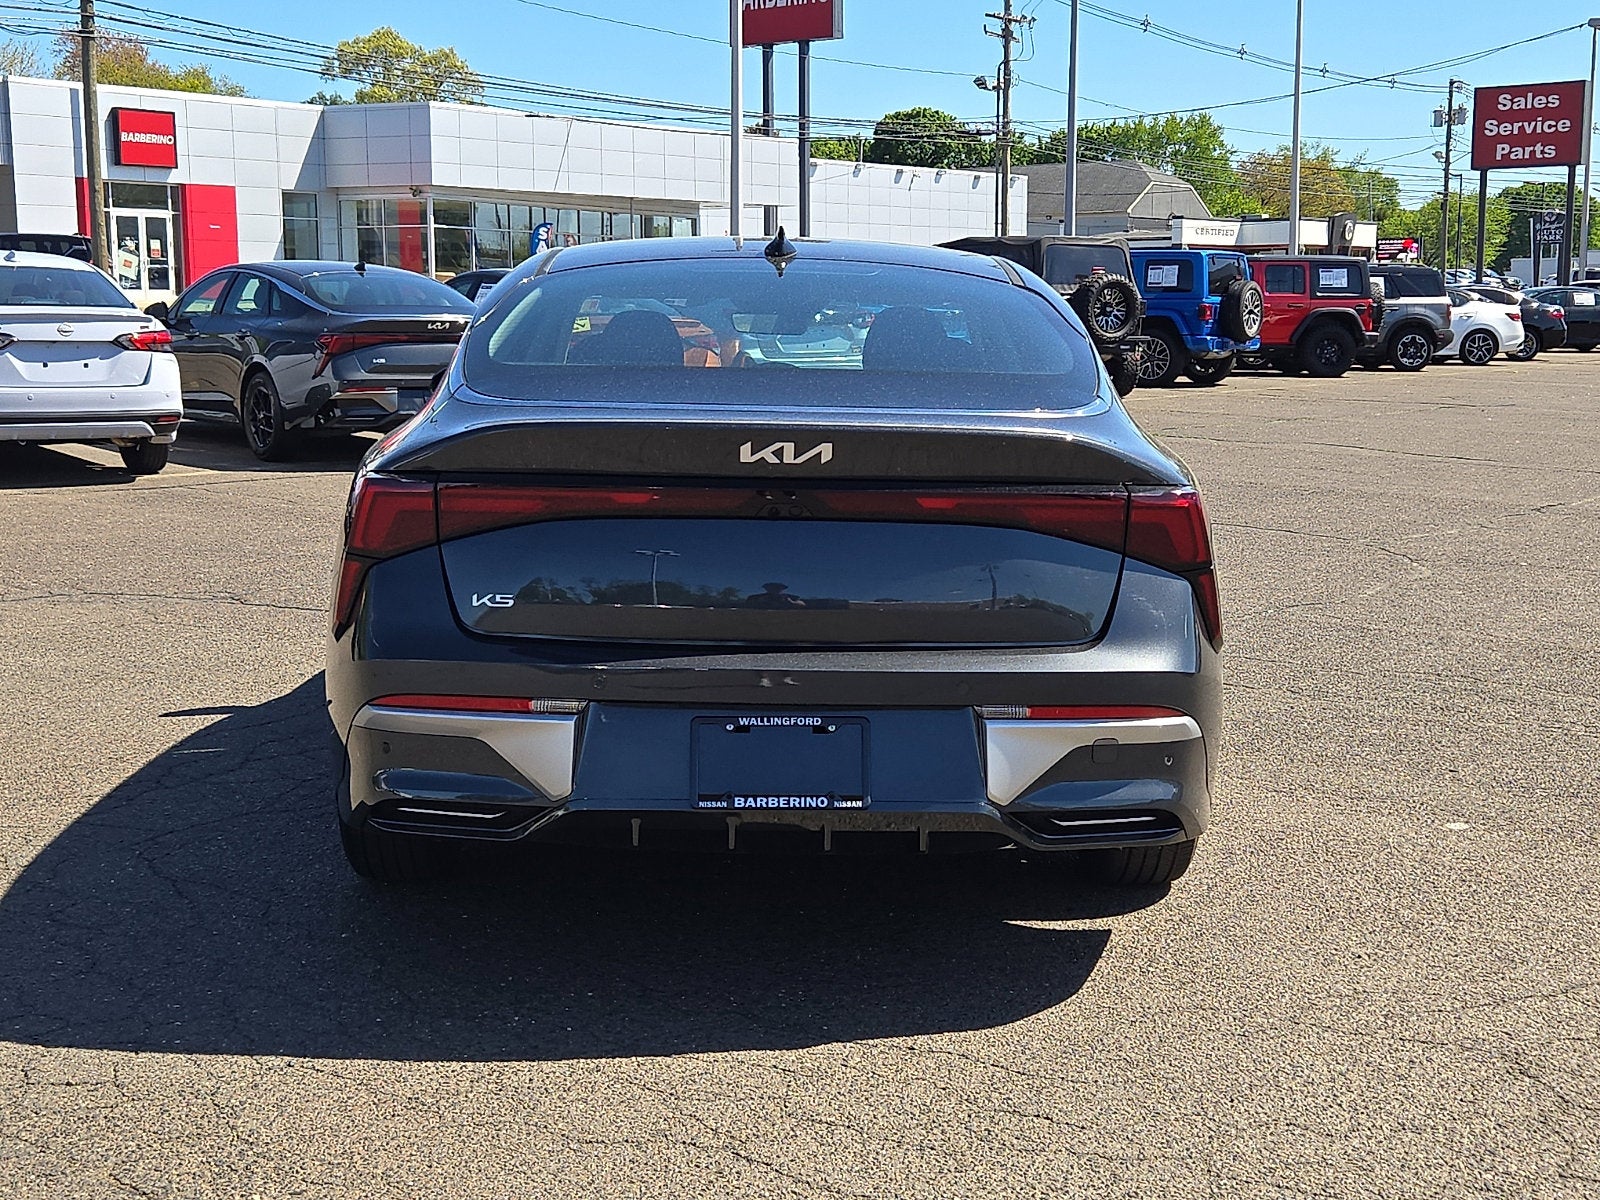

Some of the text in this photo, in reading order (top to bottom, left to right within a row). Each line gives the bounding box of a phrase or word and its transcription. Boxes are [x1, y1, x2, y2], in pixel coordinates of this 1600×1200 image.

[1497, 92, 1560, 111] Sales
[1484, 116, 1571, 136] Service
[121, 131, 174, 145] BARBERINO
[1495, 142, 1556, 160] Parts
[1195, 227, 1235, 237] CERTIFIED
[740, 441, 833, 465] KIA
[472, 593, 515, 607] K5
[738, 717, 822, 726] WALLINGFORD
[734, 796, 828, 808] BARBERINO
